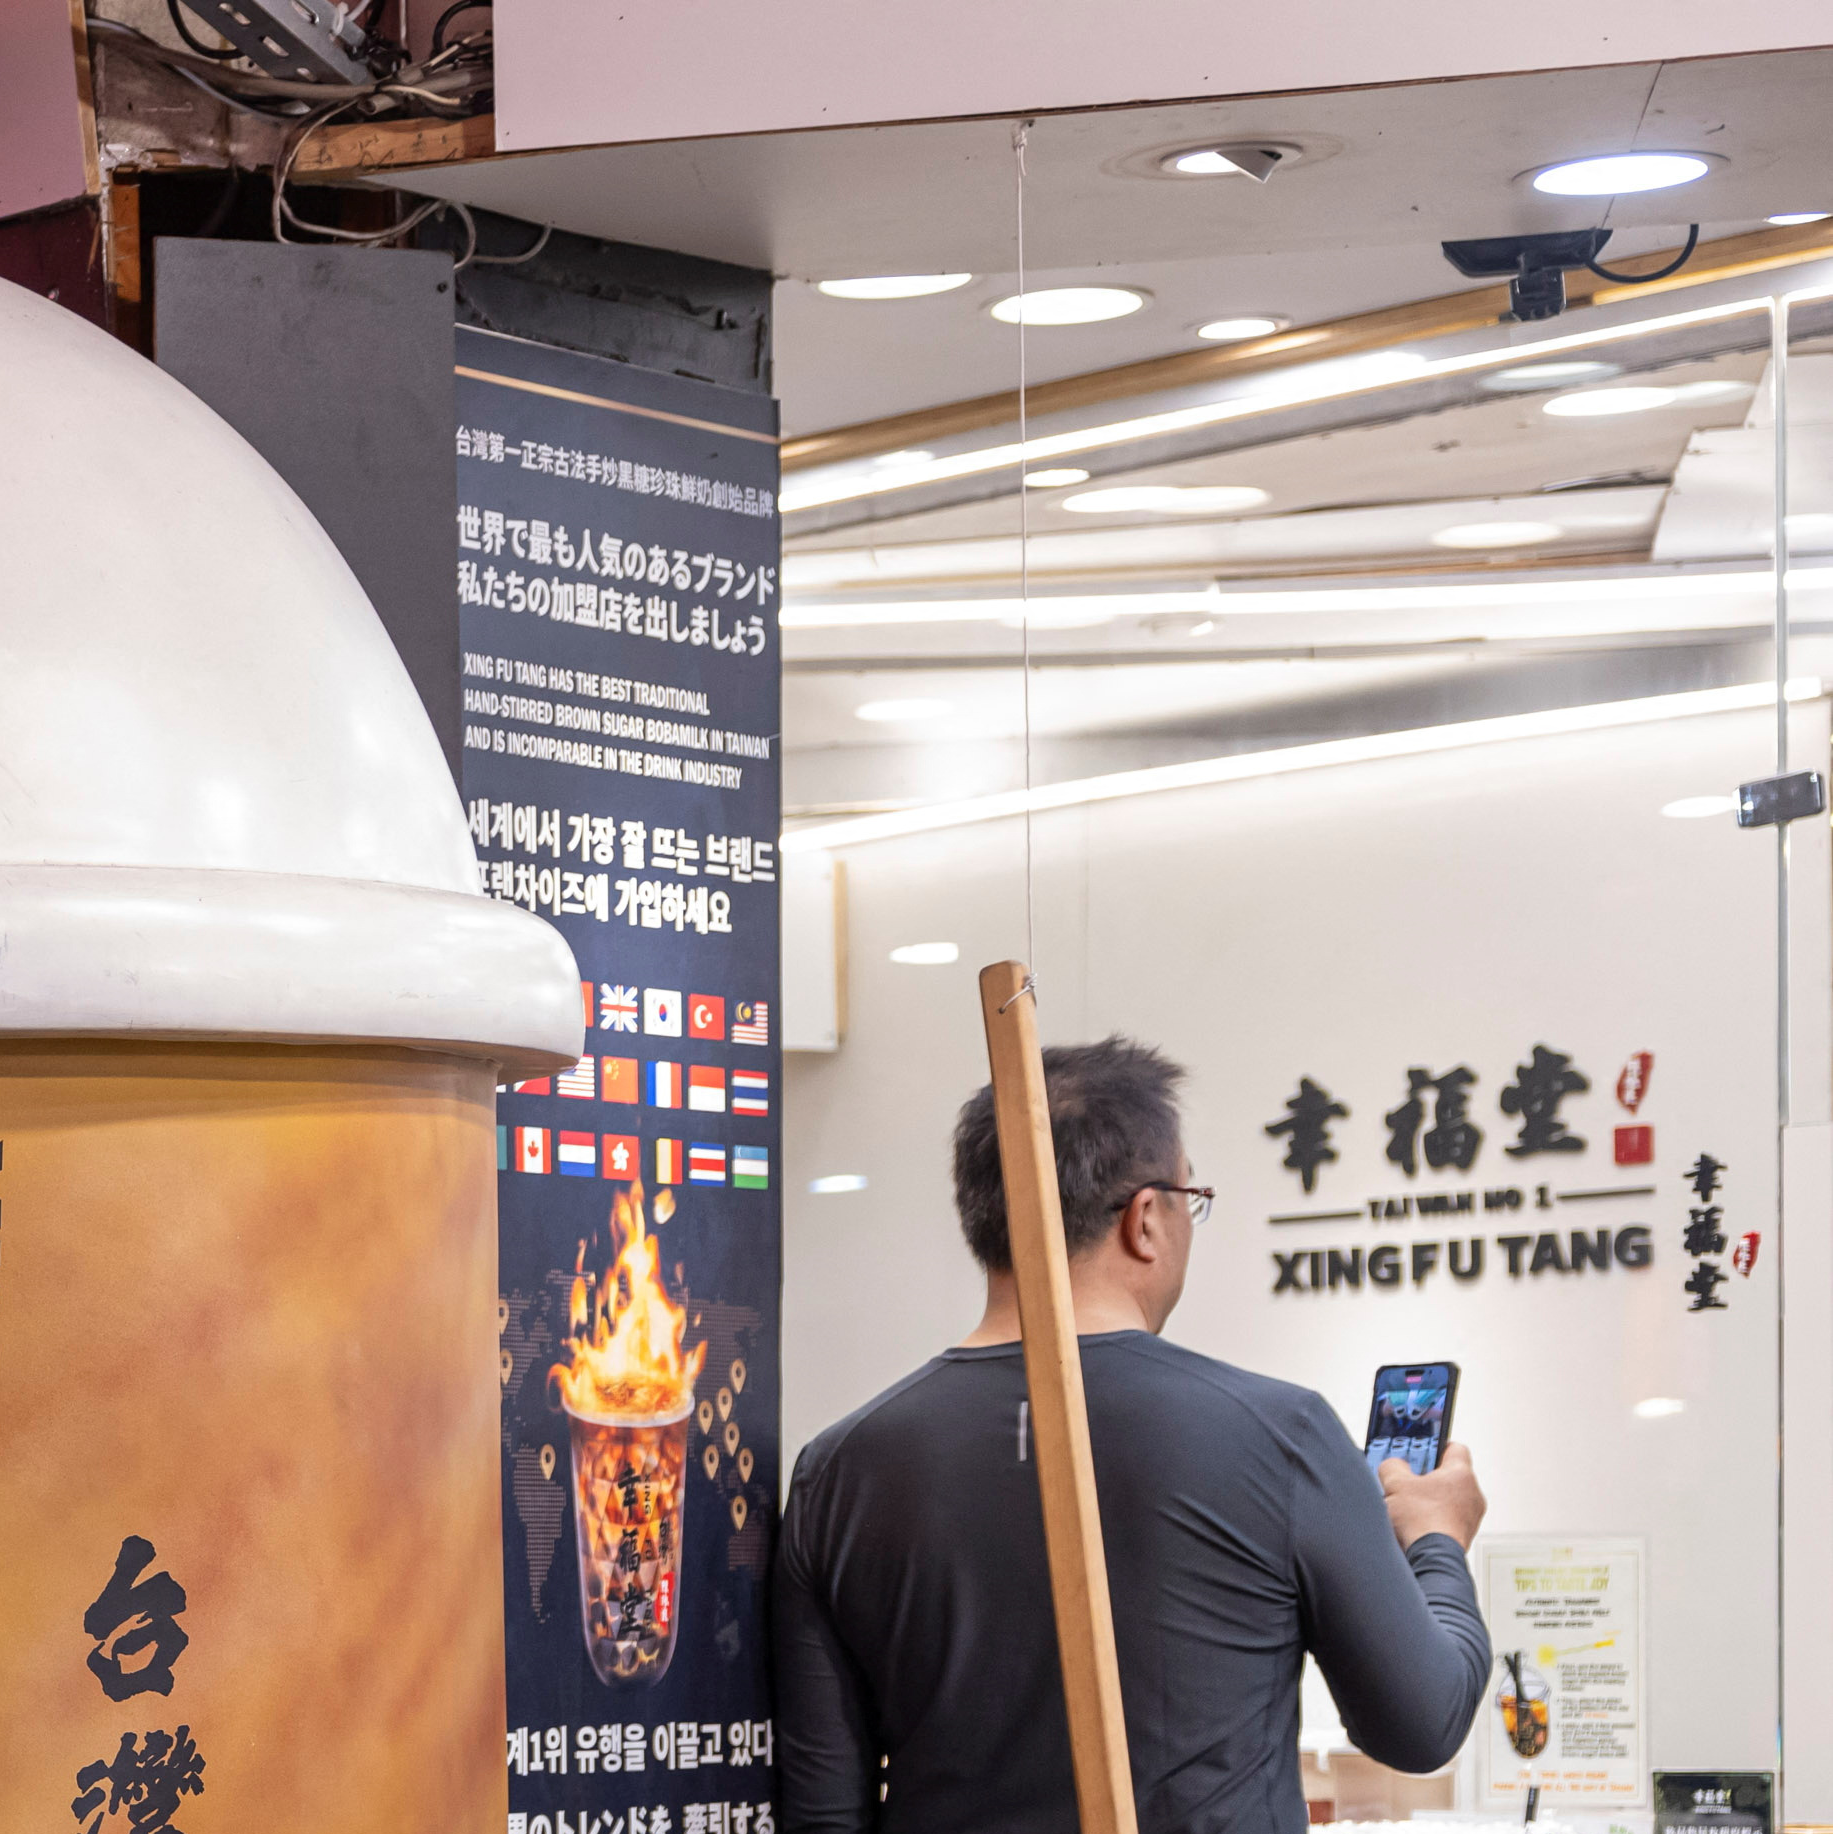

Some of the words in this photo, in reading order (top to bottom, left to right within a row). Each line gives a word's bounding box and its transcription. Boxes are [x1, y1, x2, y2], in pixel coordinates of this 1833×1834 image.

[455, 424, 775, 519] 台灣第一正宗古法手炒黑糖珍珠鮮奶創始品牌
[456, 504, 776, 606] 世界で最も人気のあるブランド
[457, 560, 766, 656] 私たちの加盟店を出しましょう
[464, 652, 494, 679] XING
[495, 657, 513, 682] FU
[515, 661, 547, 688] TANG
[548, 667, 574, 693] HAS
[575, 671, 600, 697] THE
[600, 676, 632, 702] BEST
[633, 681, 710, 716] TRADITIONAL
[464, 688, 553, 725] HAND-STIRRED
[554, 703, 601, 733] BROWN
[602, 711, 644, 740] SUGAR
[710, 729, 724, 752] IN
[725, 731, 770, 760] TAIWAN
[464, 725, 491, 750] AND
[492, 729, 505, 753] IS
[507, 731, 603, 769] INCOMPARABLE
[603, 747, 618, 771] IN
[619, 749, 643, 775] THE
[643, 753, 683, 781] DRINK
[683, 759, 742, 790] INDUSTRY
[469, 798, 561, 858] 세계에서
[567, 812, 616, 865] 가장
[620, 820, 647, 869] 잘
[651, 827, 700, 876] 뜨는
[704, 833, 776, 883] 브랜드
[614, 876, 732, 935] 가입하세요
[1264, 1042, 1590, 1194] 幸福堂
[1368, 1193, 1473, 1221] TAIWAN
[1271, 1246, 1403, 1295] XING
[1412, 1239, 1486, 1282] FU
[1497, 1226, 1654, 1278] TANG
[574, 1723, 647, 1774] 유행을
[653, 1721, 723, 1770] 이끌고
[728, 1718, 773, 1767] 있다
